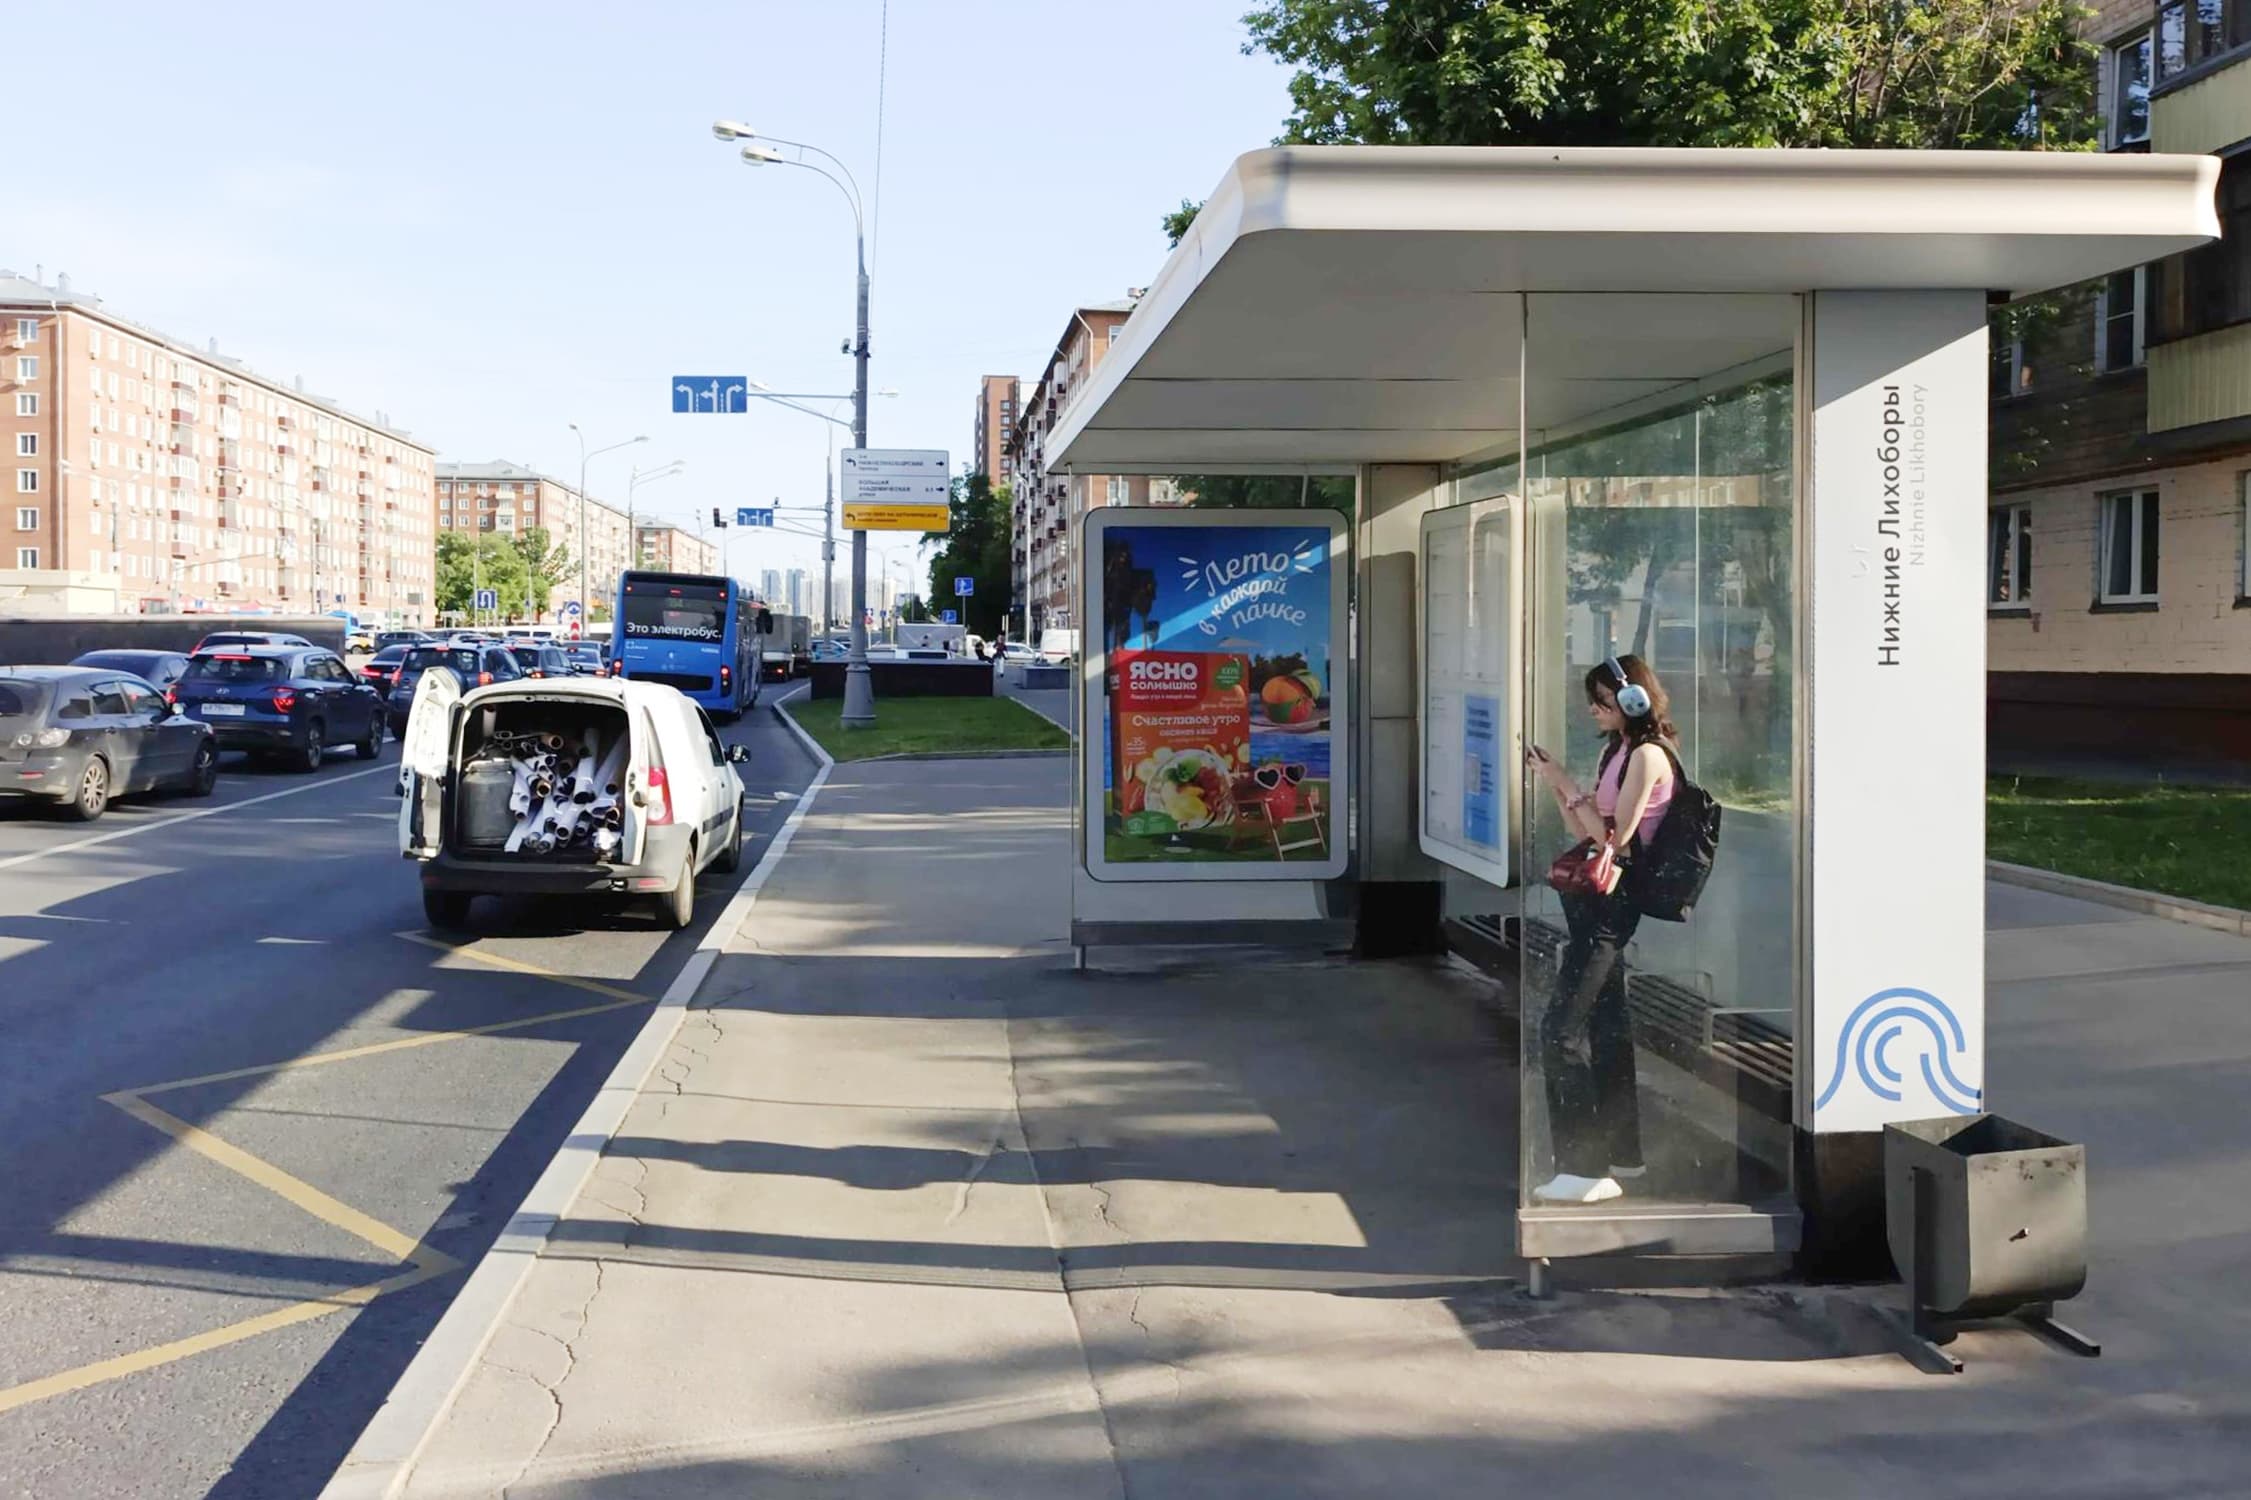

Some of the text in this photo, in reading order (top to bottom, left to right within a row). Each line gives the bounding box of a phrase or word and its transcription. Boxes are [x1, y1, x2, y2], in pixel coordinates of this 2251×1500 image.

[1909, 384, 1928, 566] Nizhnie Likhobory
[1877, 385, 1905, 666] Нижние Лихоборы
[1205, 552, 1289, 597] Лето
[1198, 576, 1288, 635] в каждой
[1231, 602, 1306, 629] пачке
[626, 622, 722, 639] Это электробус.
[1129, 661, 1198, 681] ЯСНО
[1132, 714, 1241, 727] Счастливое утро
